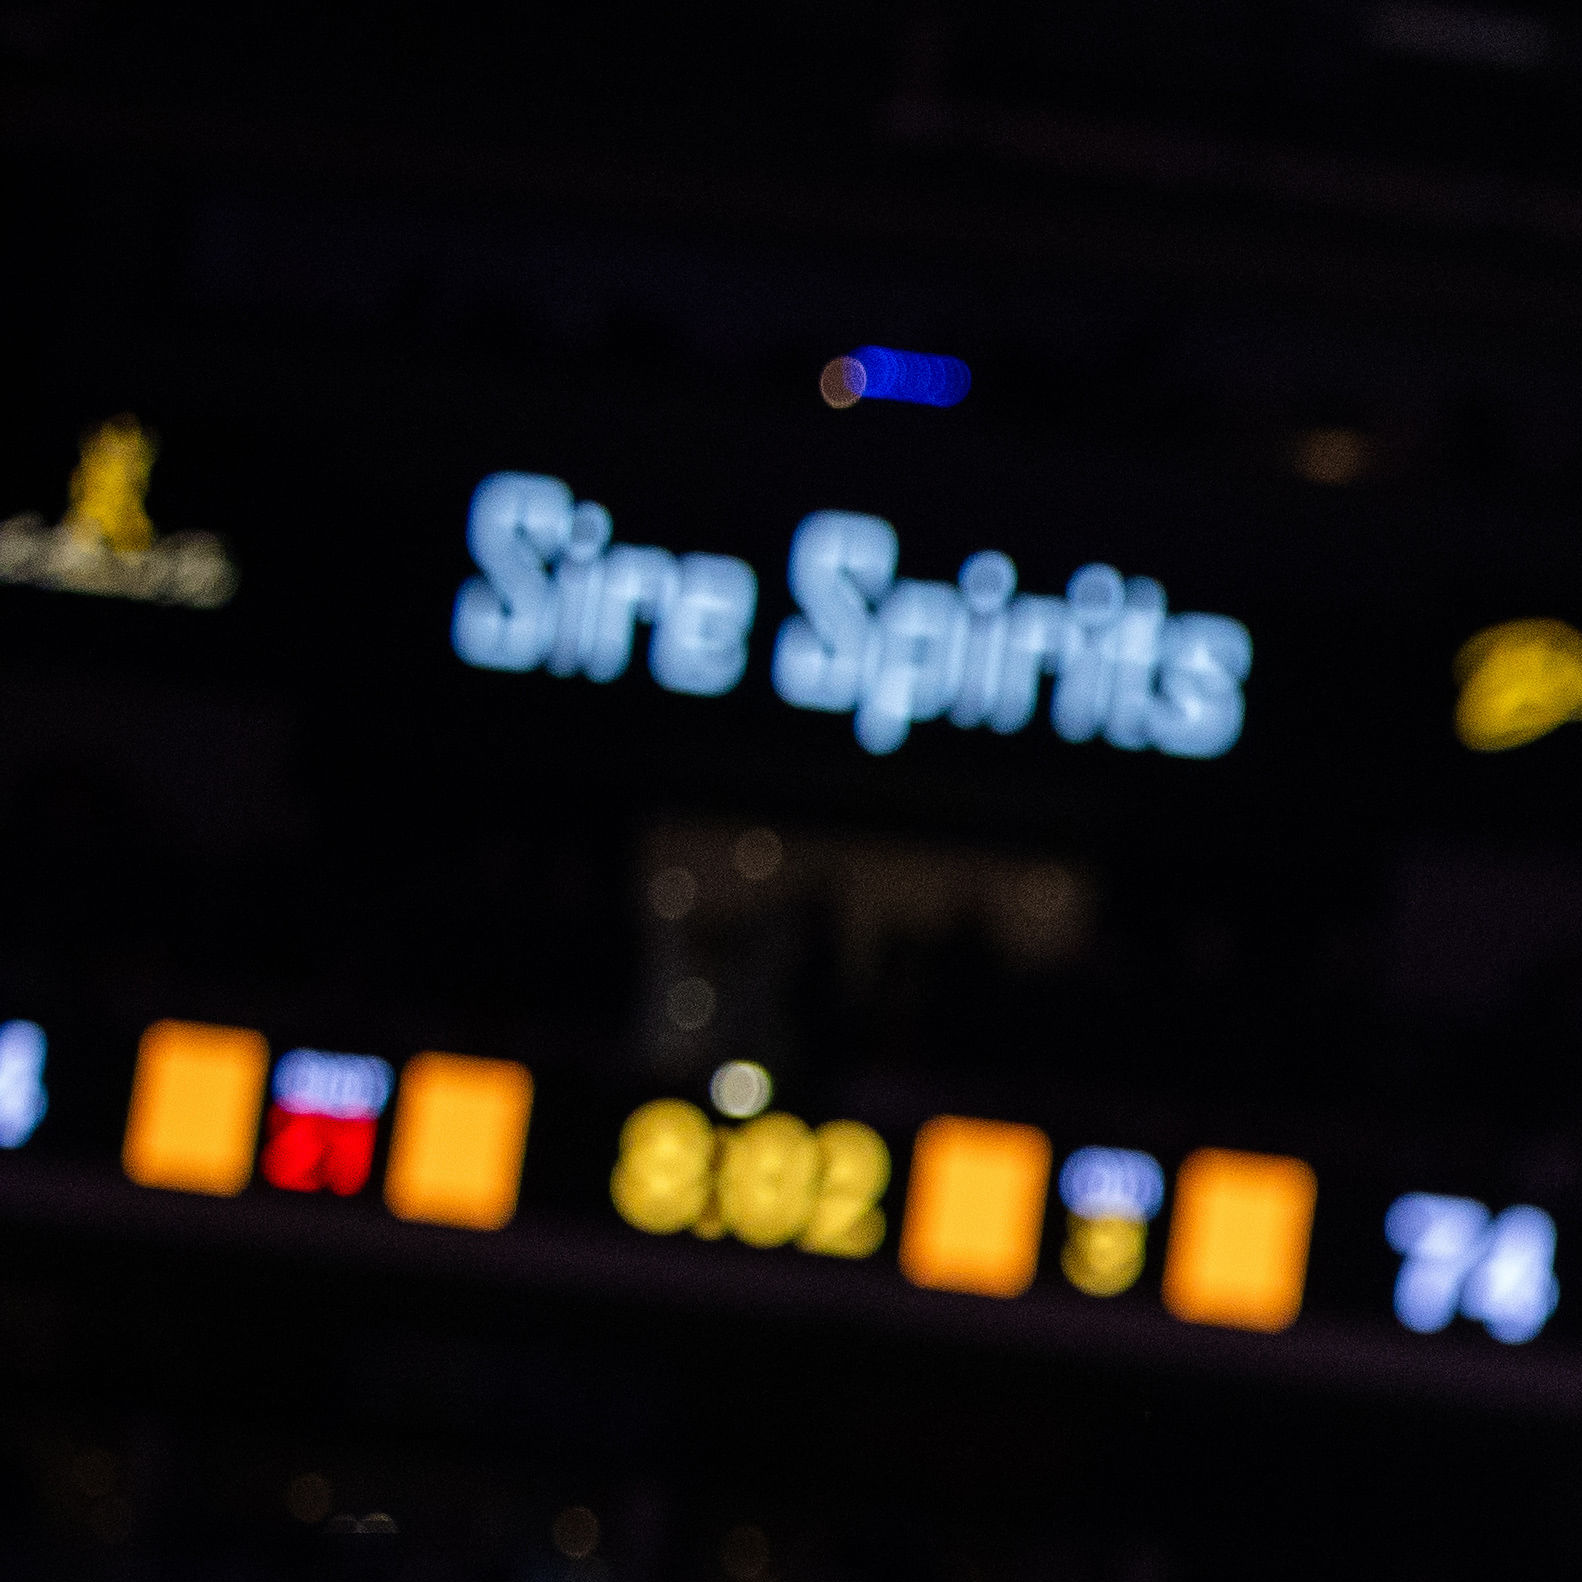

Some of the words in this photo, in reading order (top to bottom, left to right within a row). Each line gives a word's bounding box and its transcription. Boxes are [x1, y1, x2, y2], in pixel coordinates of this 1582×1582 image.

[451, 469, 759, 697] Sire
[771, 508, 1253, 760] Spirits
[1385, 1192, 1560, 1345] 74
